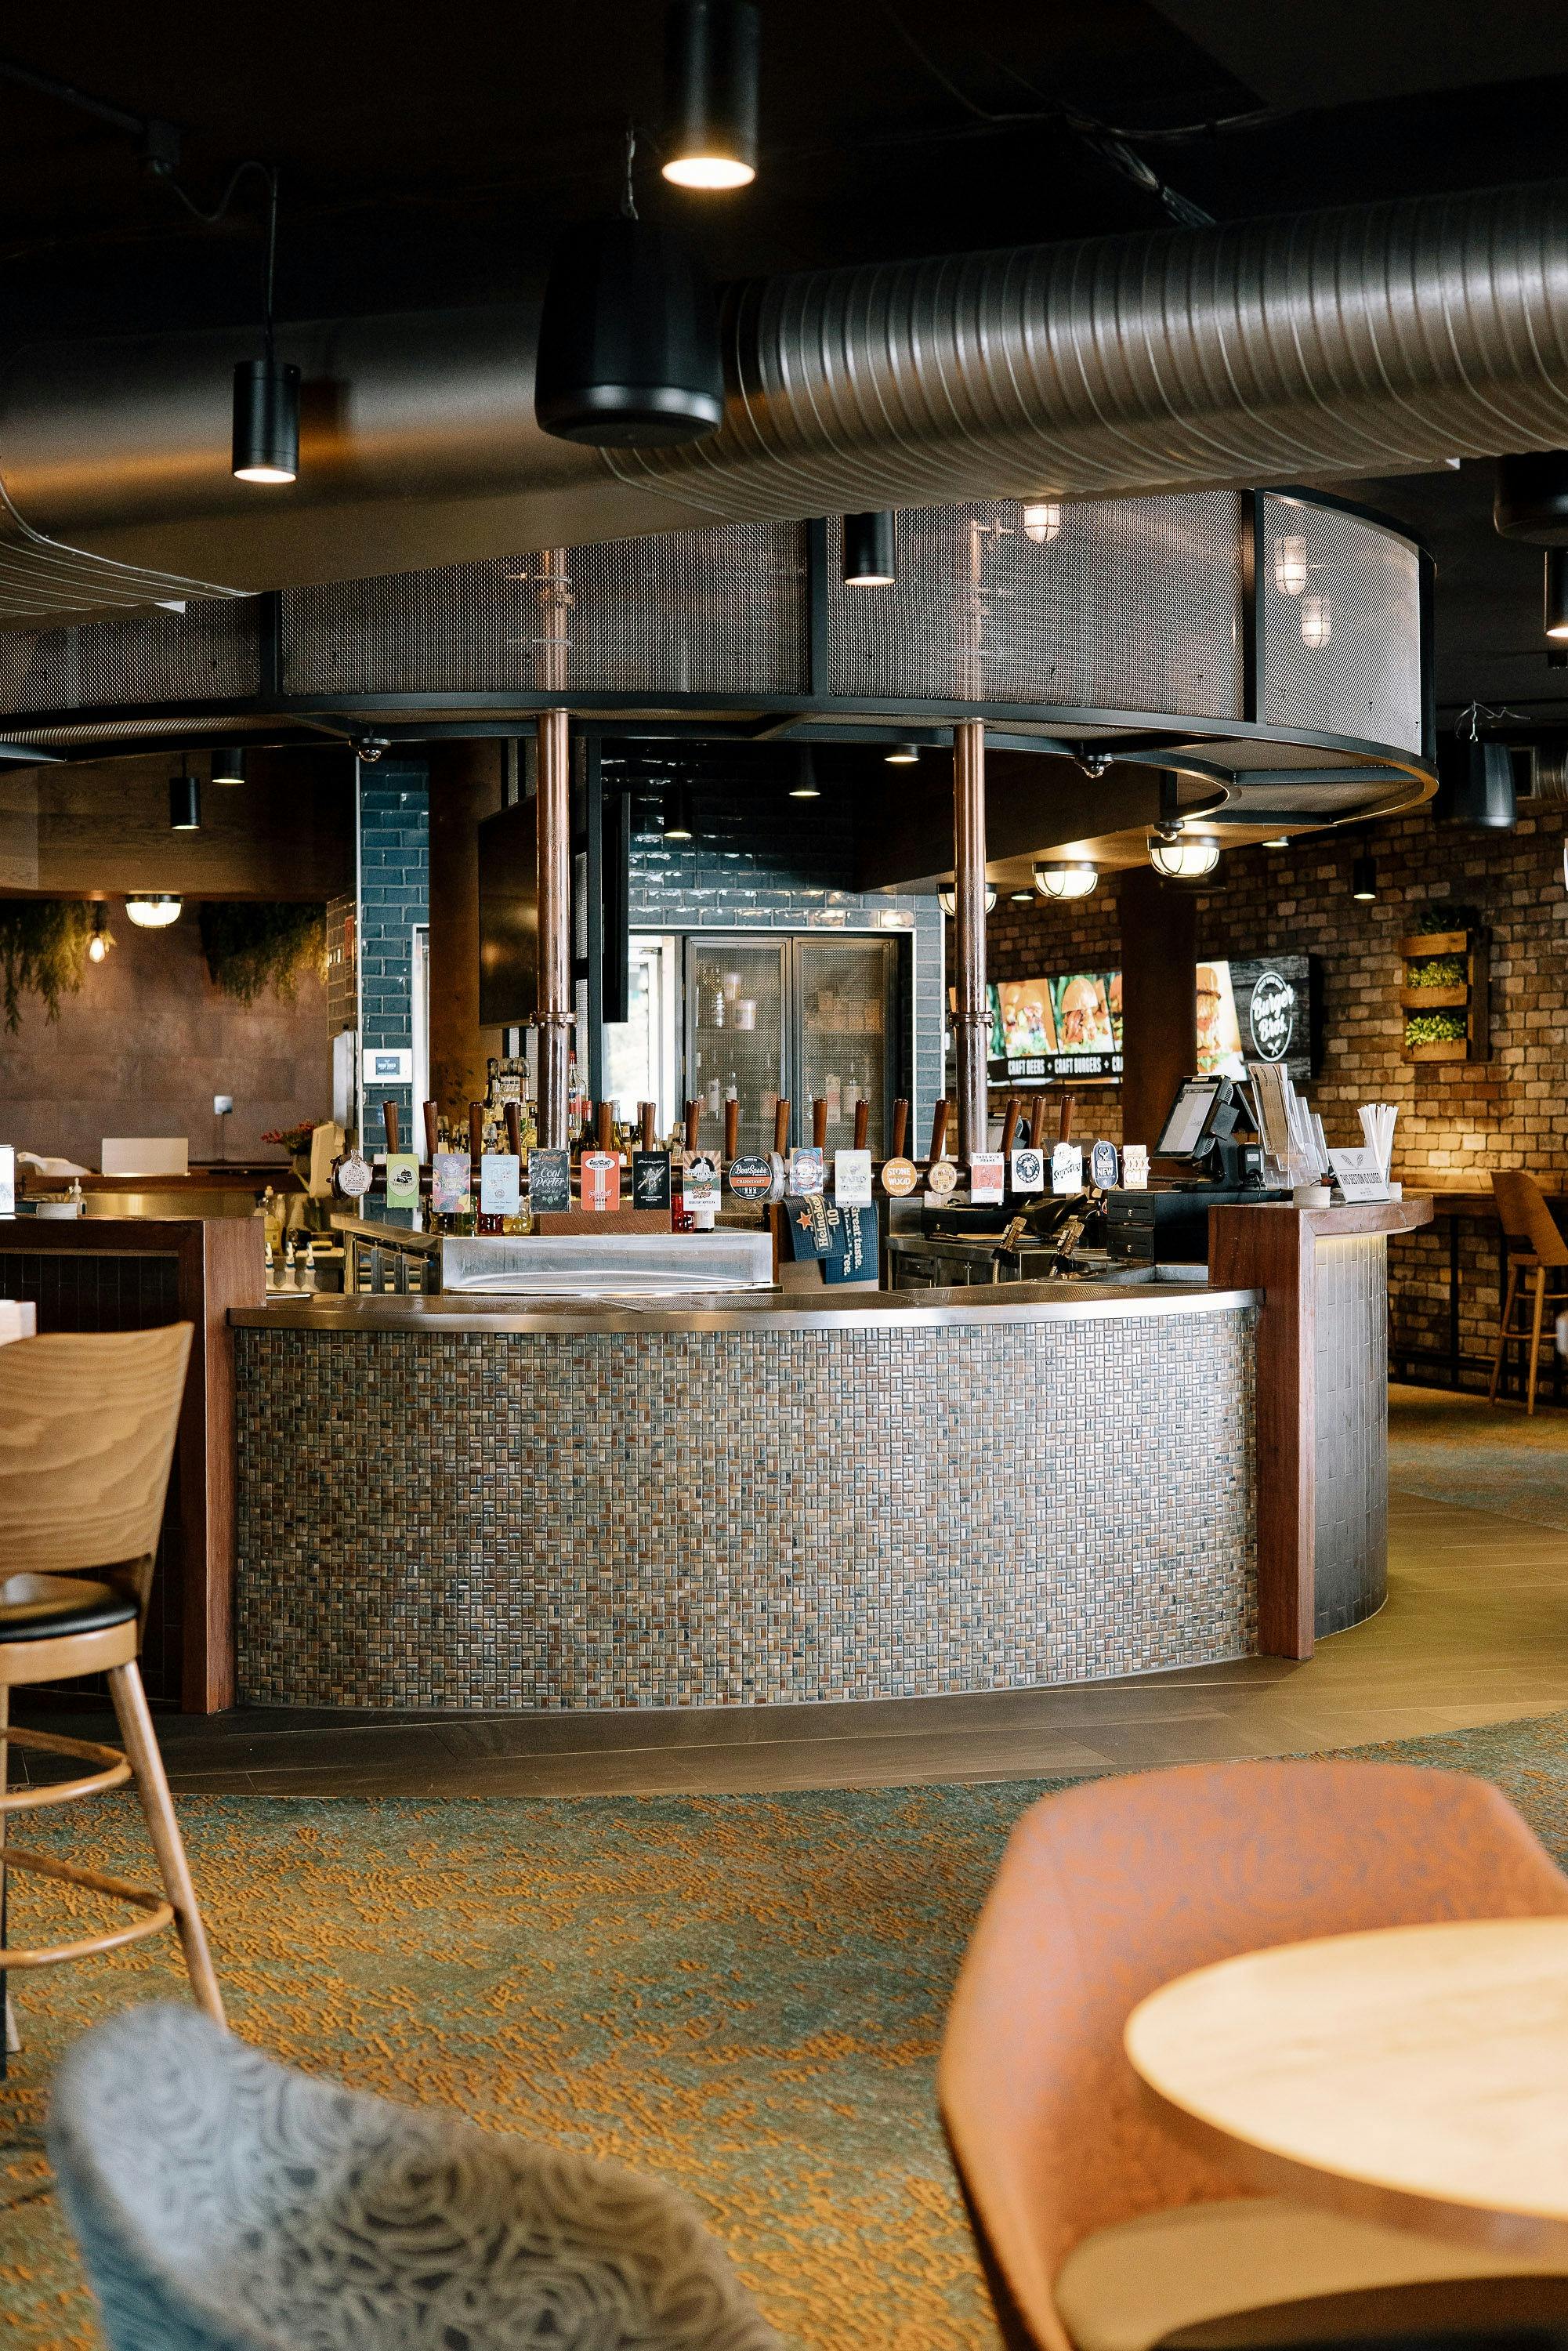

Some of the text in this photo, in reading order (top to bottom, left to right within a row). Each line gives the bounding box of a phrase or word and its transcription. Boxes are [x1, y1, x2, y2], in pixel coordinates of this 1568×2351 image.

[1252, 984, 1295, 1020] Burger
[1008, 1060, 1026, 1075] CRAFT
[1027, 1059, 1045, 1074] BEERS
[1054, 1058, 1074, 1074] CRAFT
[1074, 1056, 1101, 1073] BURGERS
[541, 1167, 562, 1178] Coal
[887, 1167, 911, 1176] STONE
[534, 1176, 565, 1187] Porter
[888, 1177, 911, 1186] WOOD
[810, 1195, 829, 1248] Heineken
